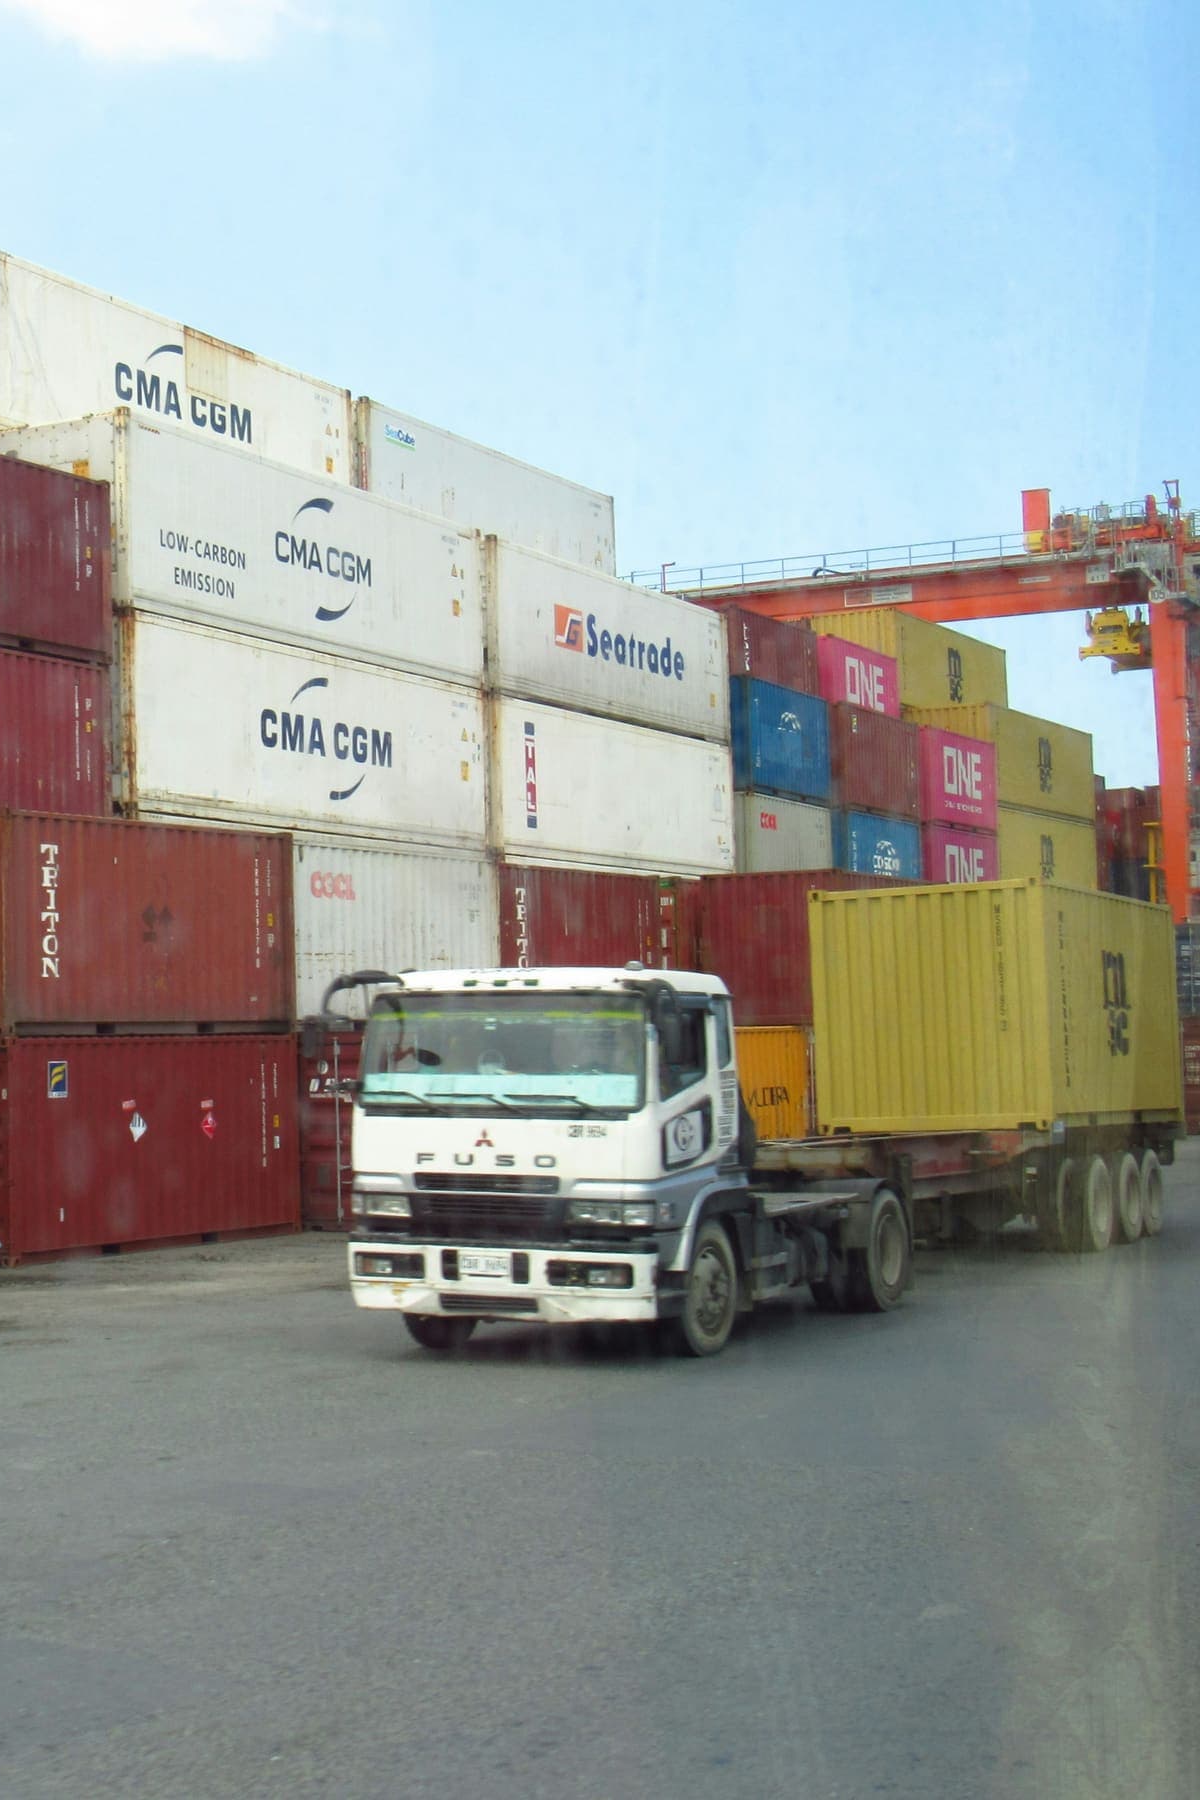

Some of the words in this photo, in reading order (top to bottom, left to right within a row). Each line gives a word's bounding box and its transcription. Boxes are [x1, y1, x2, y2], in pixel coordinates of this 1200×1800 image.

[115, 362, 182, 419] CMA
[191, 395, 252, 444] CGM
[159, 529, 246, 570] LOW-CARBON
[275, 530, 322, 573] CMA
[327, 547, 372, 587] CGM
[174, 567, 235, 599] EMISSION
[587, 613, 684, 681] Seatrade
[845, 656, 886, 713] ONE
[260, 708, 326, 757] CMA
[334, 724, 392, 768] CGM
[943, 746, 982, 800] ONE
[40, 844, 60, 978] TRITON
[515, 887, 528, 968] TRITO
[416, 1152, 557, 1169] FUSO
